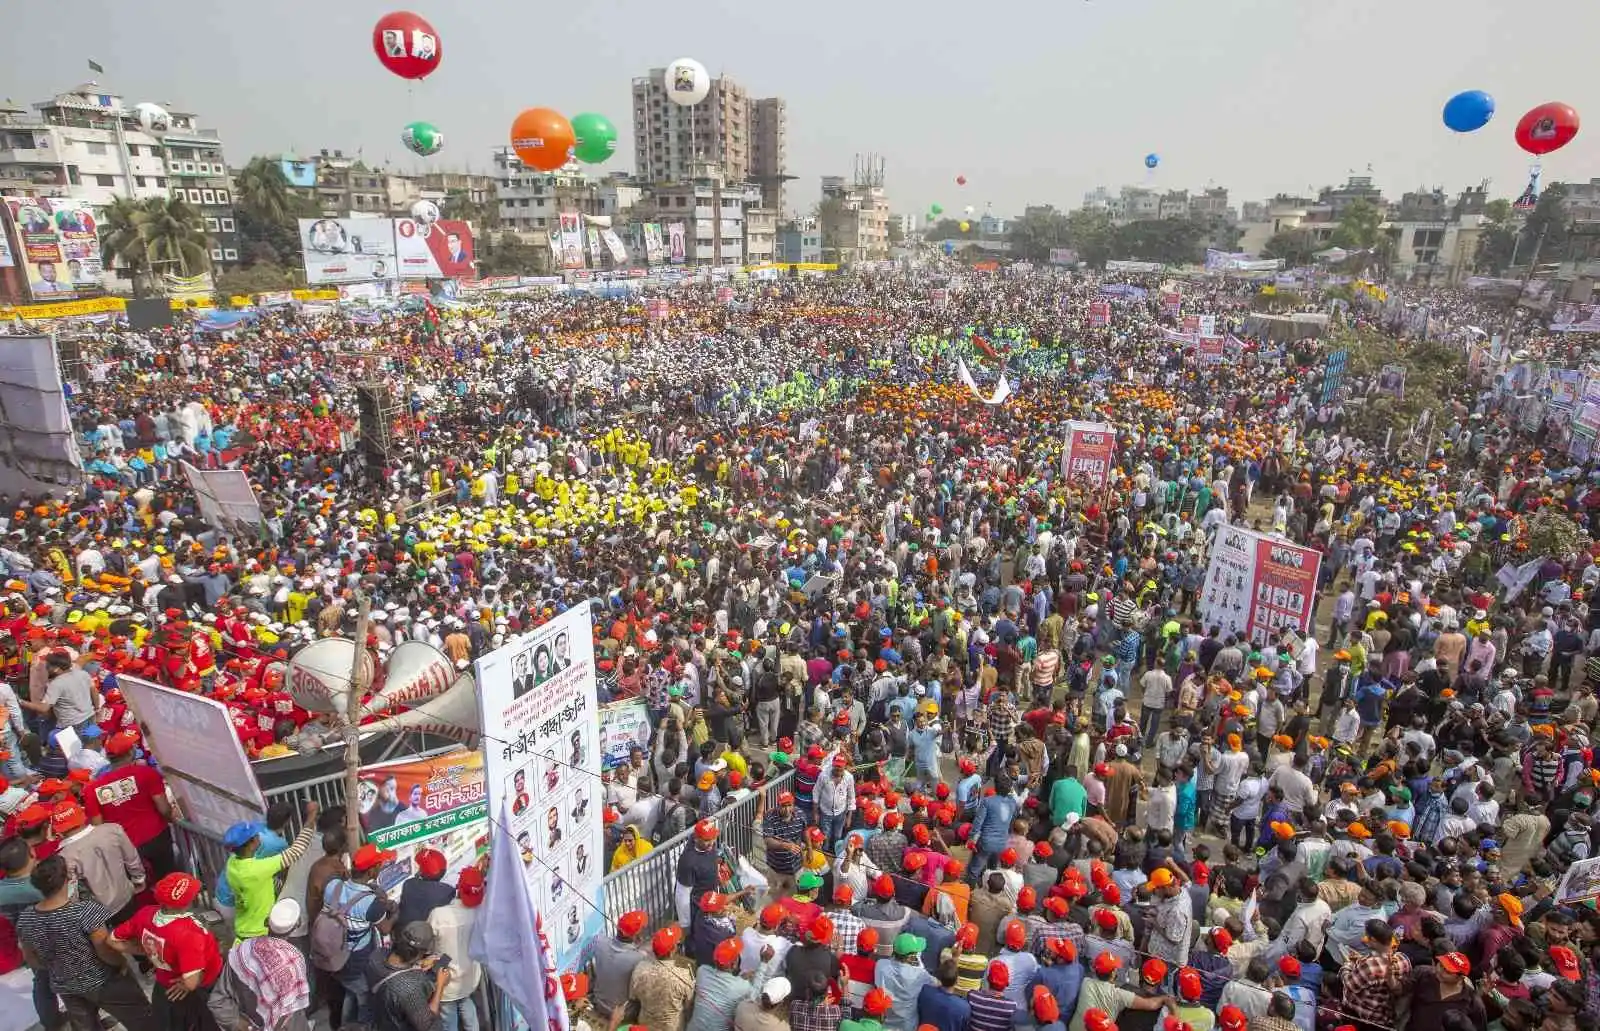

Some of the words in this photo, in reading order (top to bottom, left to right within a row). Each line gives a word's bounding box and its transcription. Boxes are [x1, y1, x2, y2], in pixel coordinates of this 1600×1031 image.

[503, 728, 536, 761] গভীর
[539, 691, 586, 738] শ্রদ্ধাঞ্জলি
[376, 823, 421, 844] আরাফাত
[424, 813, 456, 830] রহমান
